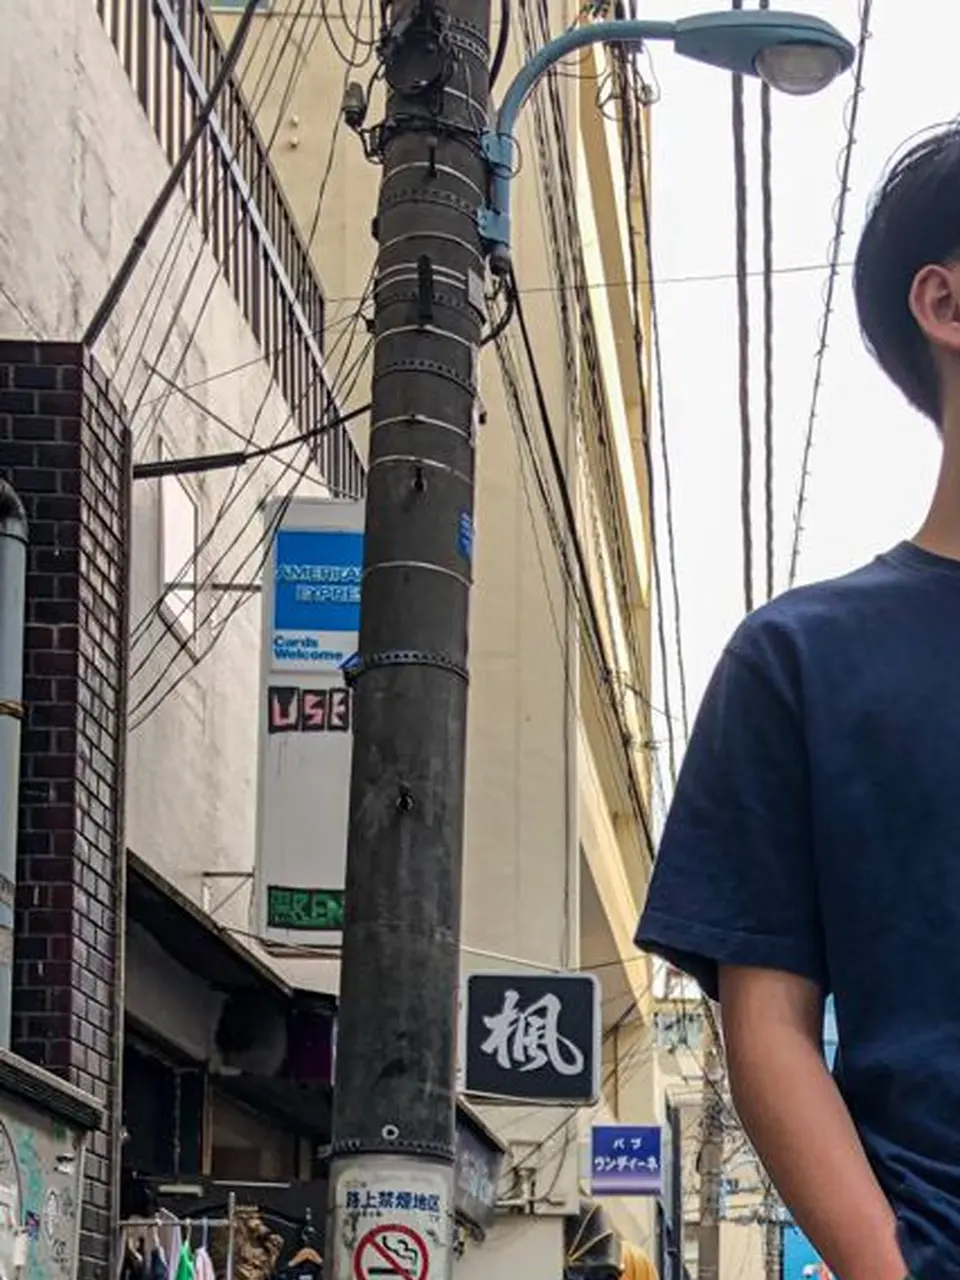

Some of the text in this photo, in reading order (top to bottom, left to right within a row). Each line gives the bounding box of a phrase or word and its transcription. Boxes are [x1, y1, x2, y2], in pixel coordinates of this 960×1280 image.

[276, 564, 363, 581] AMERICA
[296, 585, 361, 602] EXPRE
[274, 635, 318, 648] Cards
[275, 648, 344, 660] Welcome
[481, 988, 585, 1076] 楓
[345, 1190, 441, 1213] 路上禁煙地区
